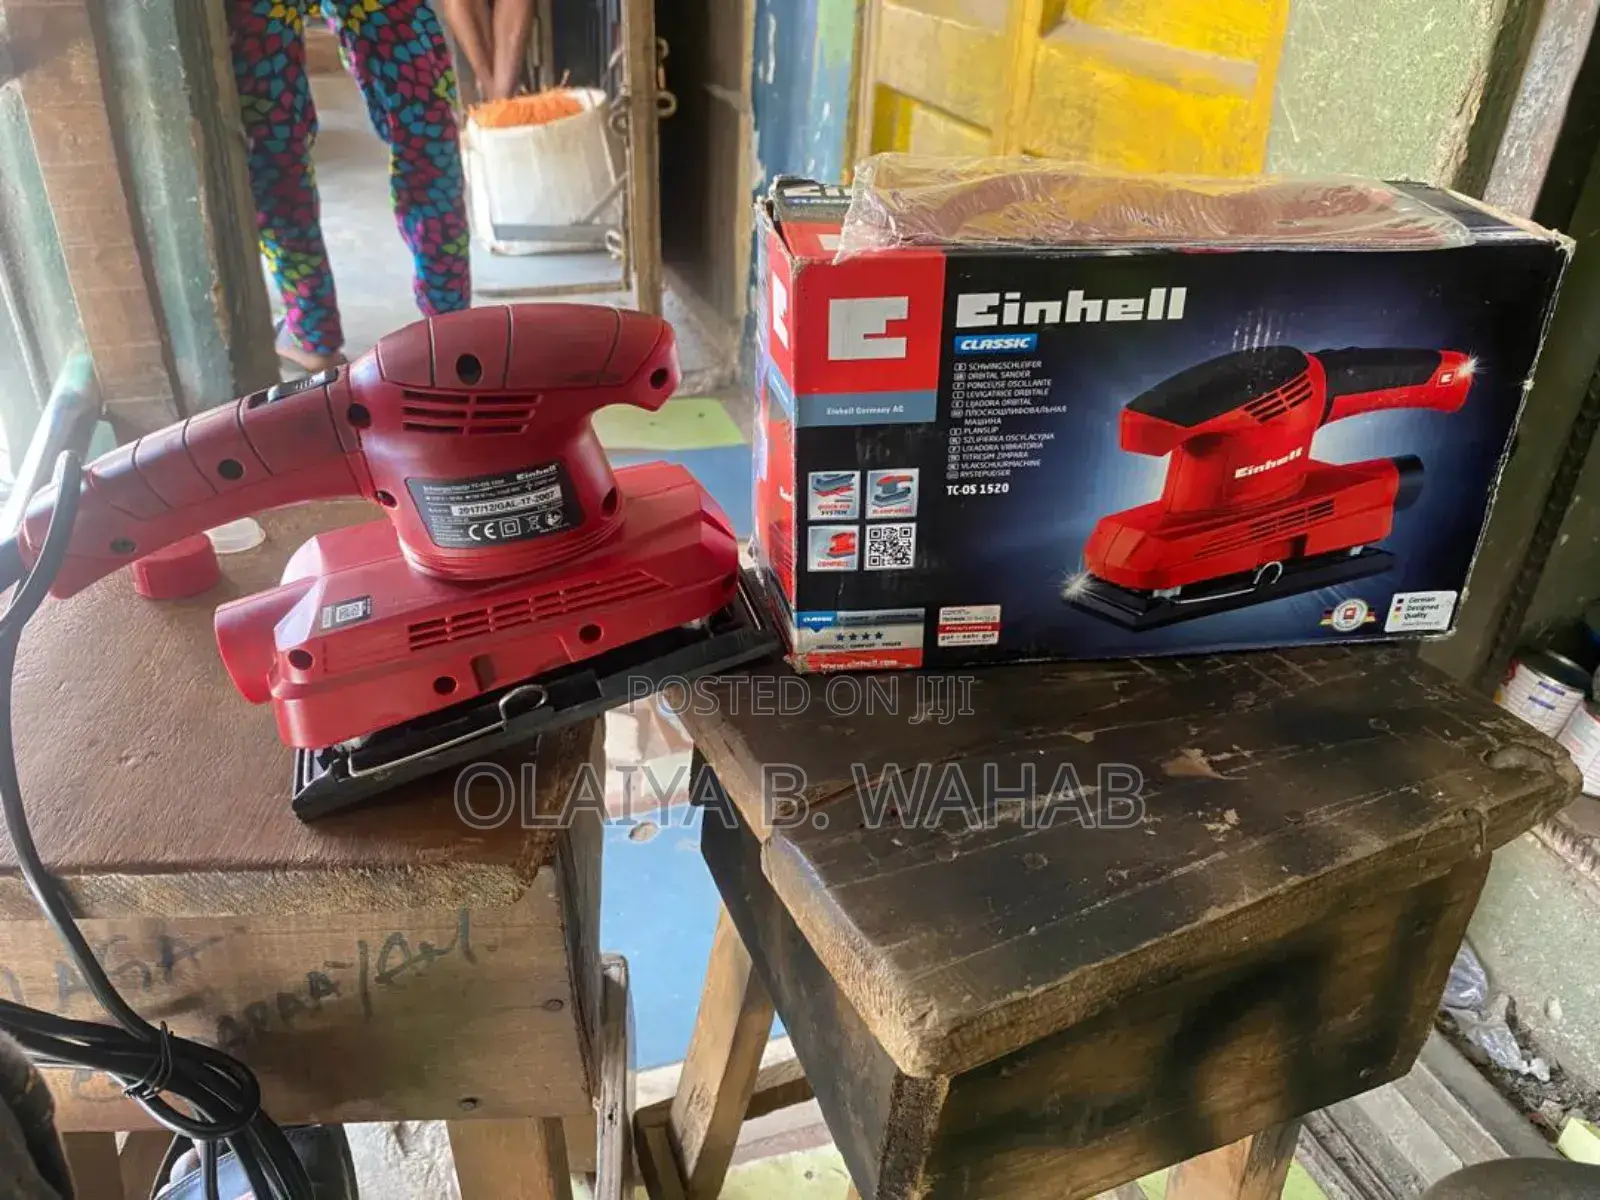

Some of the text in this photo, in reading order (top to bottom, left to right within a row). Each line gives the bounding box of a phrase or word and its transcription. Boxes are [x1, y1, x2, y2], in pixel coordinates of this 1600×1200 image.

[955, 287, 1187, 328] Einhell
[961, 336, 1031, 350] CLASSIC
[968, 361, 1042, 370] SCHWINGSCHLEIFER
[967, 370, 1031, 380] ORBITAL SANDER
[966, 379, 1051, 389] PONCEUSE OSCILLANTE
[966, 388, 1049, 398] LEVIGATRICE ORBITALE
[1001, 399, 1031, 407] ORBITAL
[855, 406, 891, 415] Germany
[1234, 446, 1303, 479] Einhell
[516, 465, 557, 480] Einhell
[946, 482, 1010, 496] TC-OS 1520
[1408, 596, 1437, 604] German
[1406, 604, 1440, 612] Designed
[1403, 612, 1429, 620] Quality
